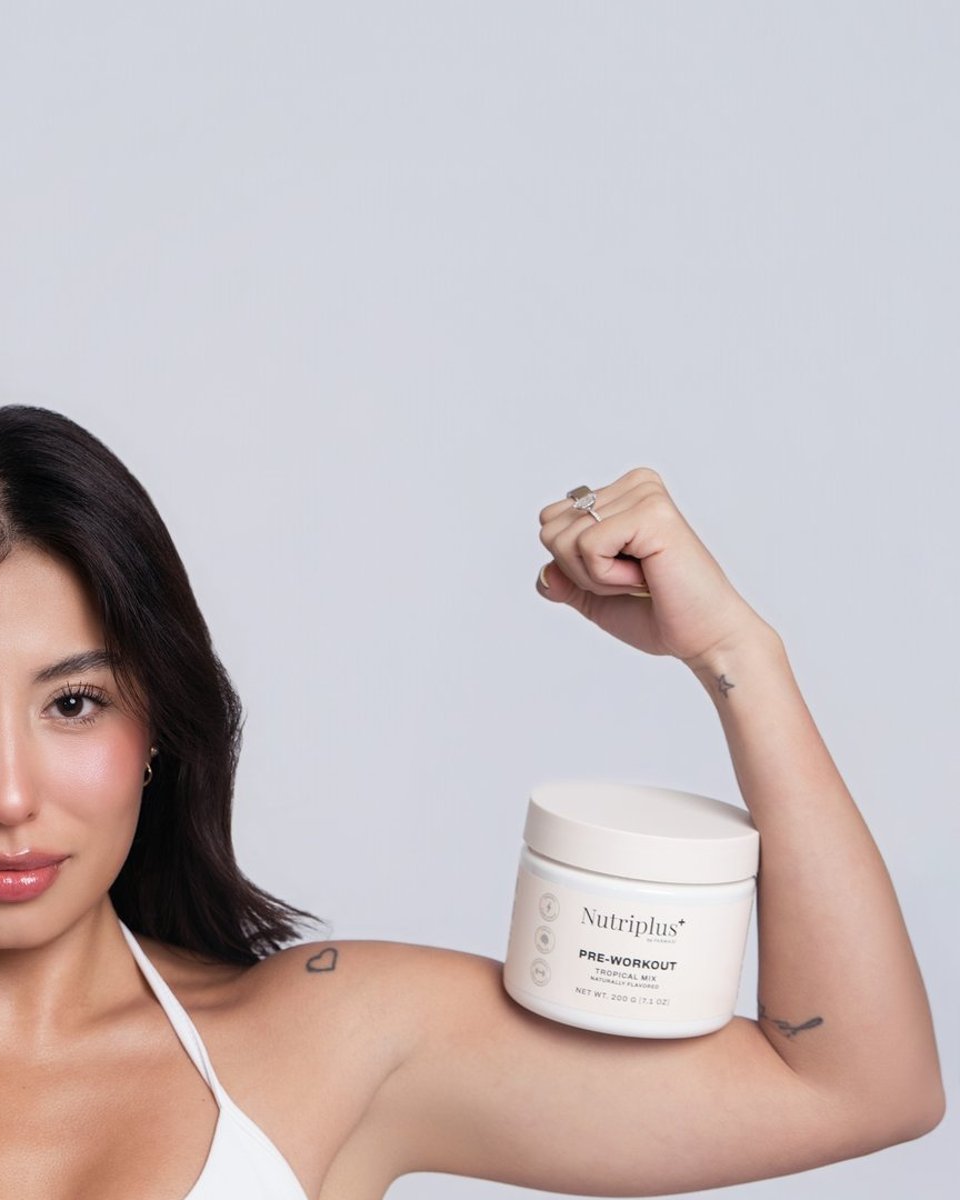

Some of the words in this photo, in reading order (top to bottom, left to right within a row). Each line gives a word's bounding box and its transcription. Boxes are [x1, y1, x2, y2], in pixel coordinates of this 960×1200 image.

[579, 949, 677, 971] PRE-WORKOUT
[595, 968, 638, 980] TROPICAL
[590, 975, 625, 986] NATURALLY
[627, 981, 659, 989] FLAVORED
[575, 987, 592, 995] NET
